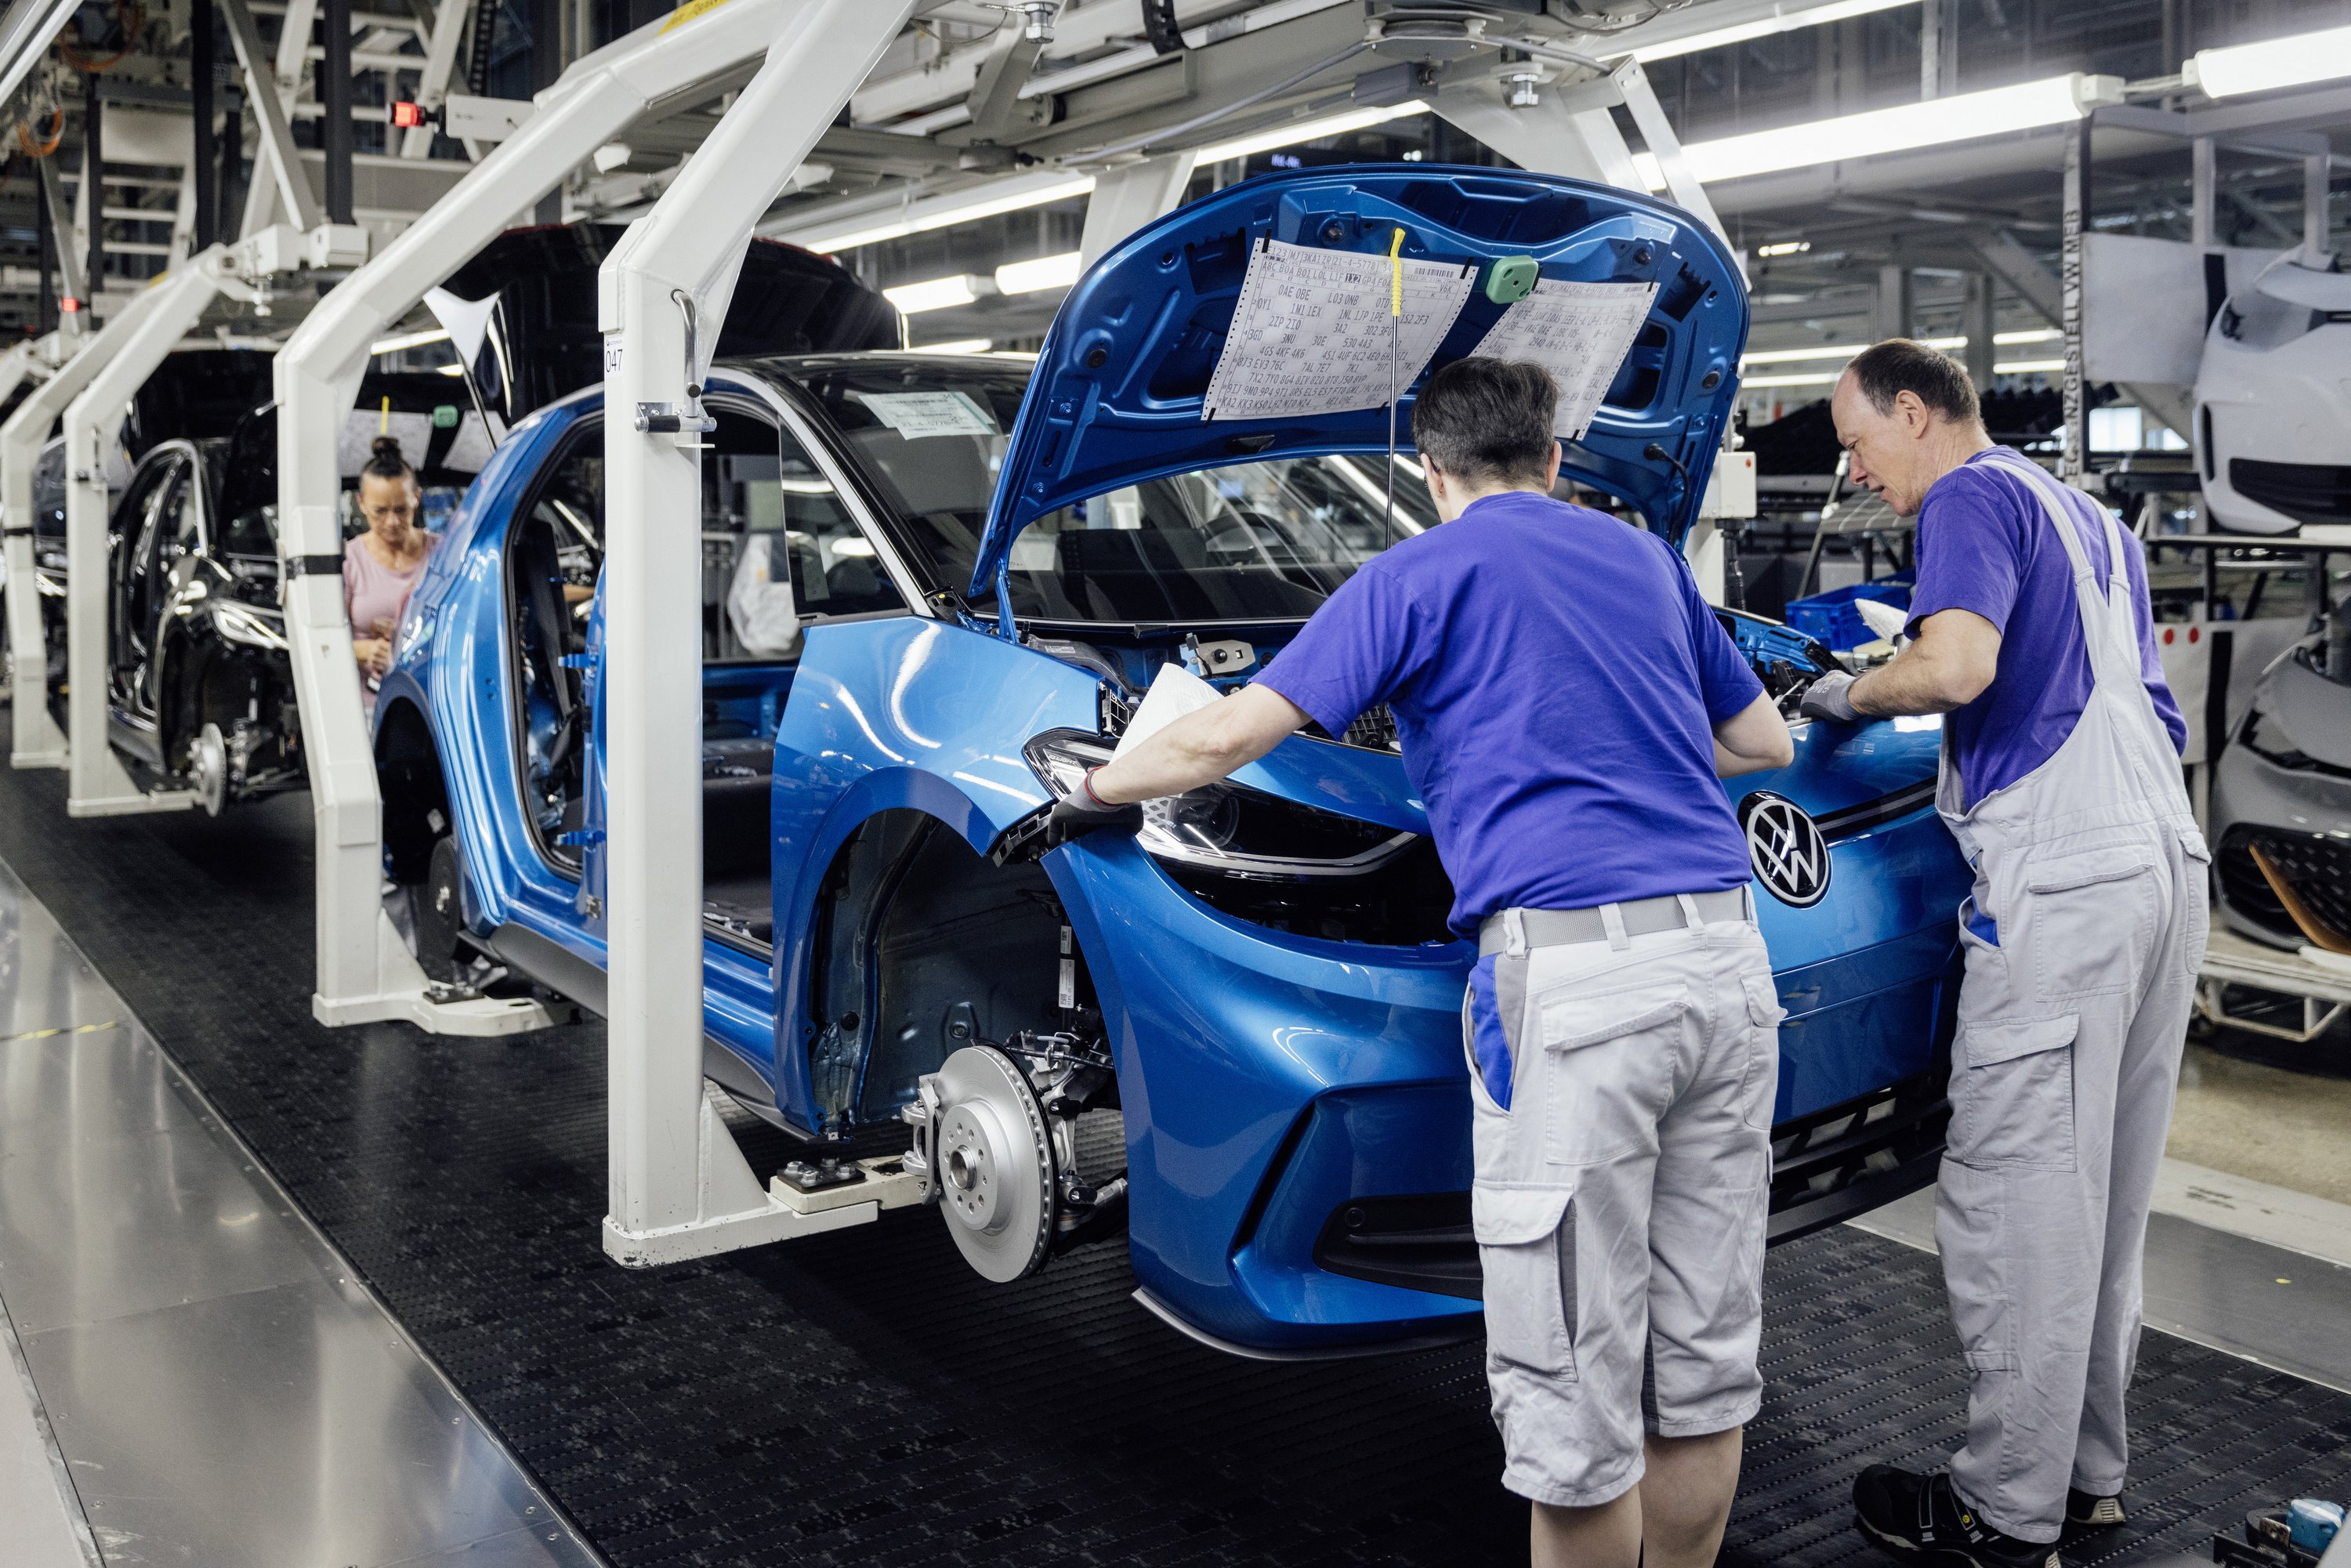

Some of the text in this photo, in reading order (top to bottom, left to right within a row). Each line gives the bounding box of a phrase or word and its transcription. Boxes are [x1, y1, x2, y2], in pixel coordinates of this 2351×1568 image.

[1333, 255, 1376, 270] 21-4-5778
[2064, 263, 2080, 293] VW
[606, 349, 623, 373] 047
[1751, 801, 1826, 898] VW
